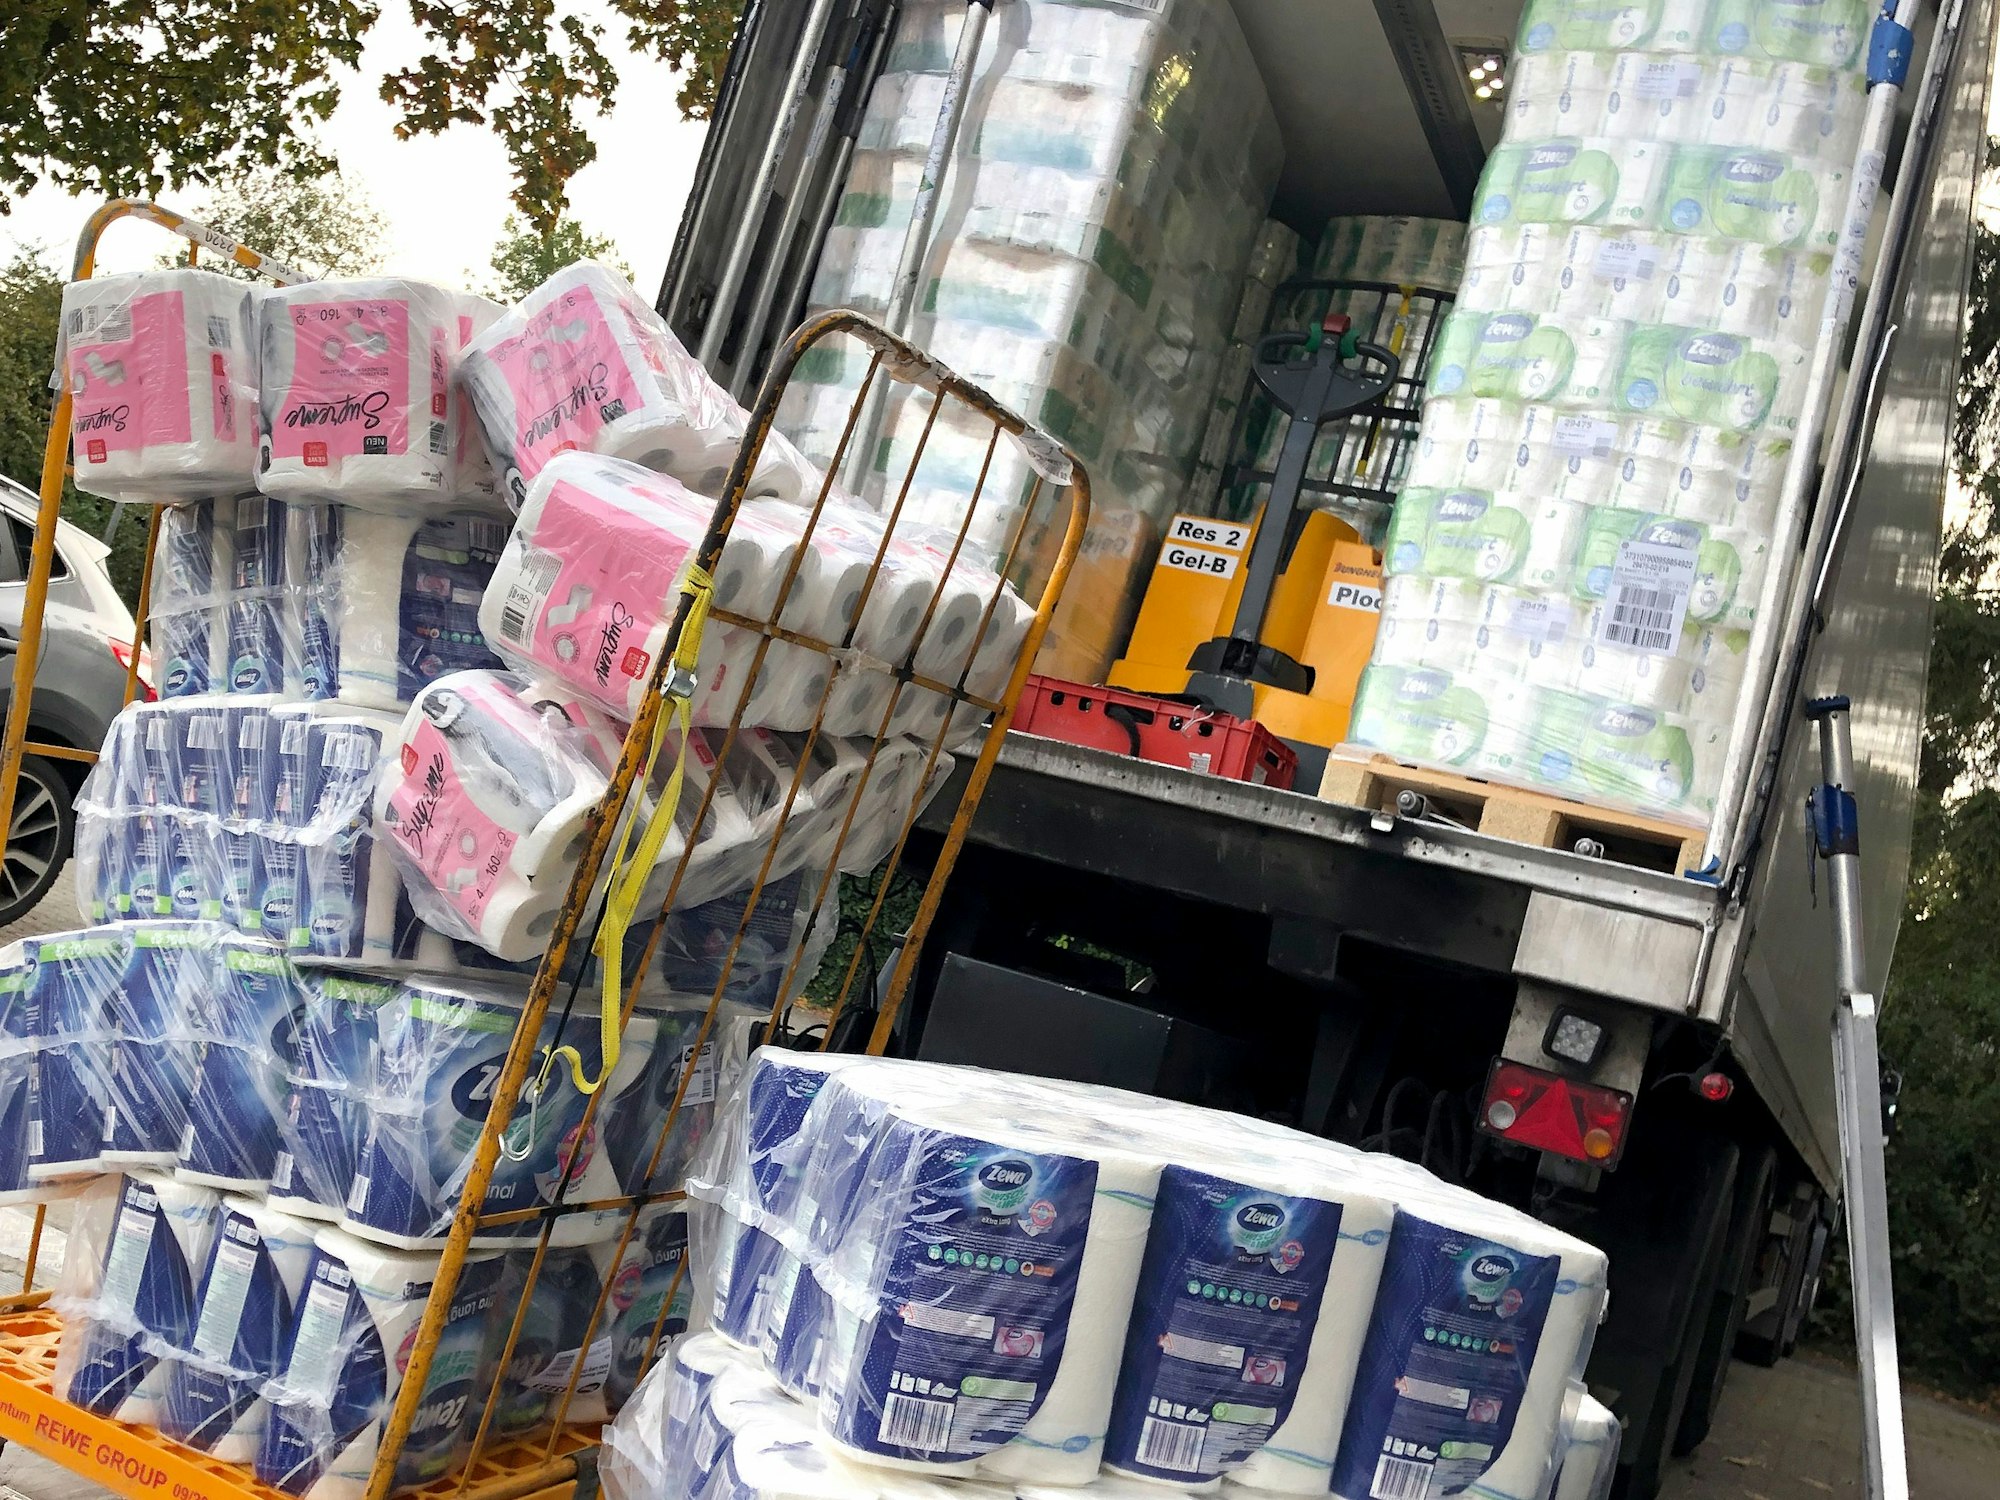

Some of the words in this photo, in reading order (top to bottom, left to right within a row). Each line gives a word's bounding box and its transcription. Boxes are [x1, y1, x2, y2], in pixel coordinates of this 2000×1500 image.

[320, 309, 340, 321] 160
[284, 390, 390, 429] Supreme
[523, 361, 610, 446] Supreme
[366, 437, 385, 446] NEU
[1177, 521, 1217, 543] Res
[1227, 531, 1241, 546] 2
[1169, 550, 1228, 574] Gel-B
[593, 601, 634, 688] Supreme
[634, 655, 647, 676] REWE
[402, 752, 445, 858] Supreme
[485, 855, 500, 876] 160
[987, 1165, 1026, 1185] Zewa
[1244, 1207, 1279, 1227] Zewa
[35, 1413, 91, 1459] REWE
[95, 1434, 168, 1490] GROUP
